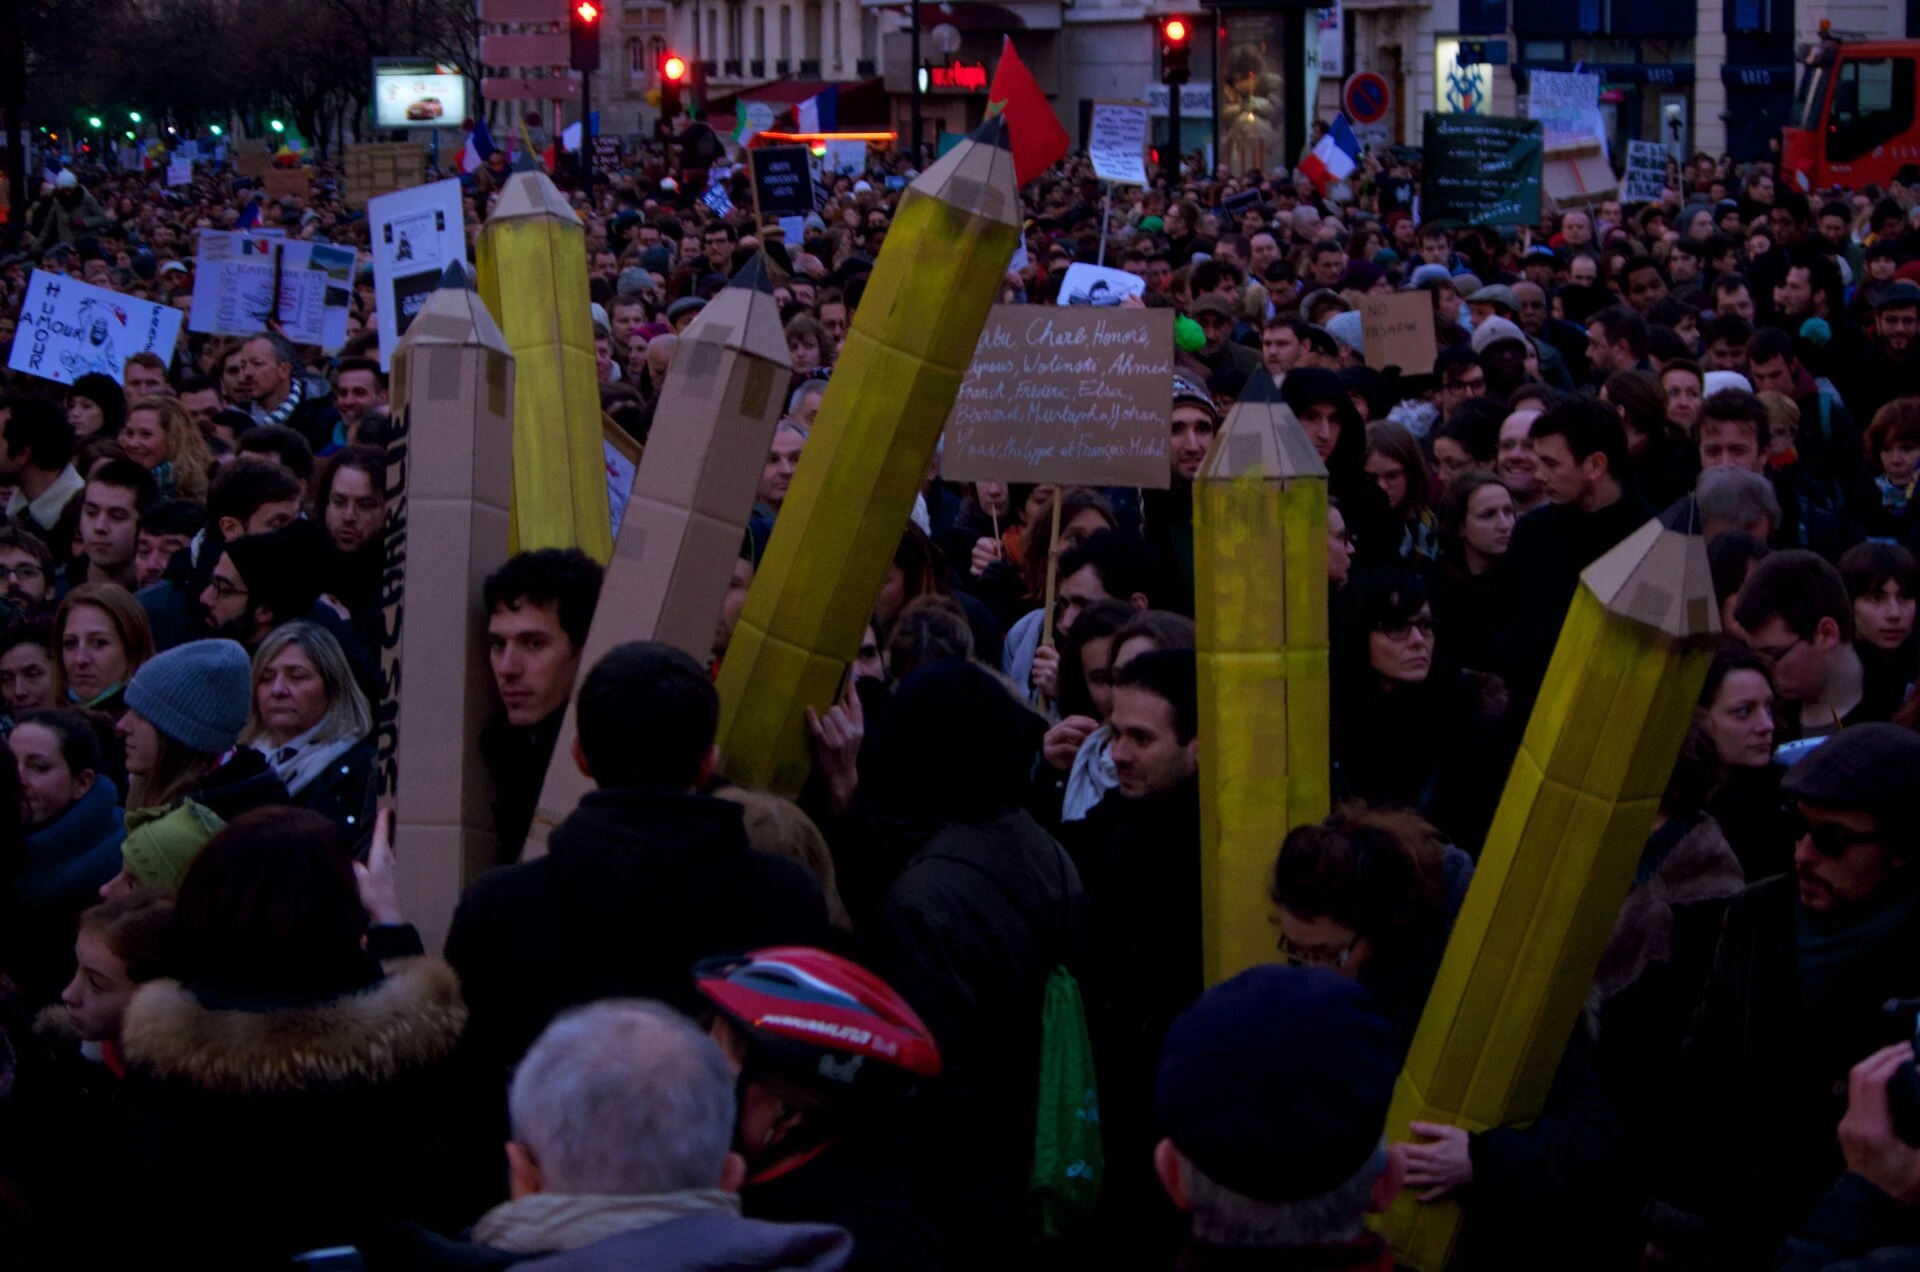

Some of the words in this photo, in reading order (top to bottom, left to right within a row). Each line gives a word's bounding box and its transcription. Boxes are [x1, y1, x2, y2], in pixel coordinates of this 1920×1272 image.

[1368, 303, 1388, 317] NO
[977, 323, 1019, 351] abu,
[377, 657, 401, 796] SUIS
